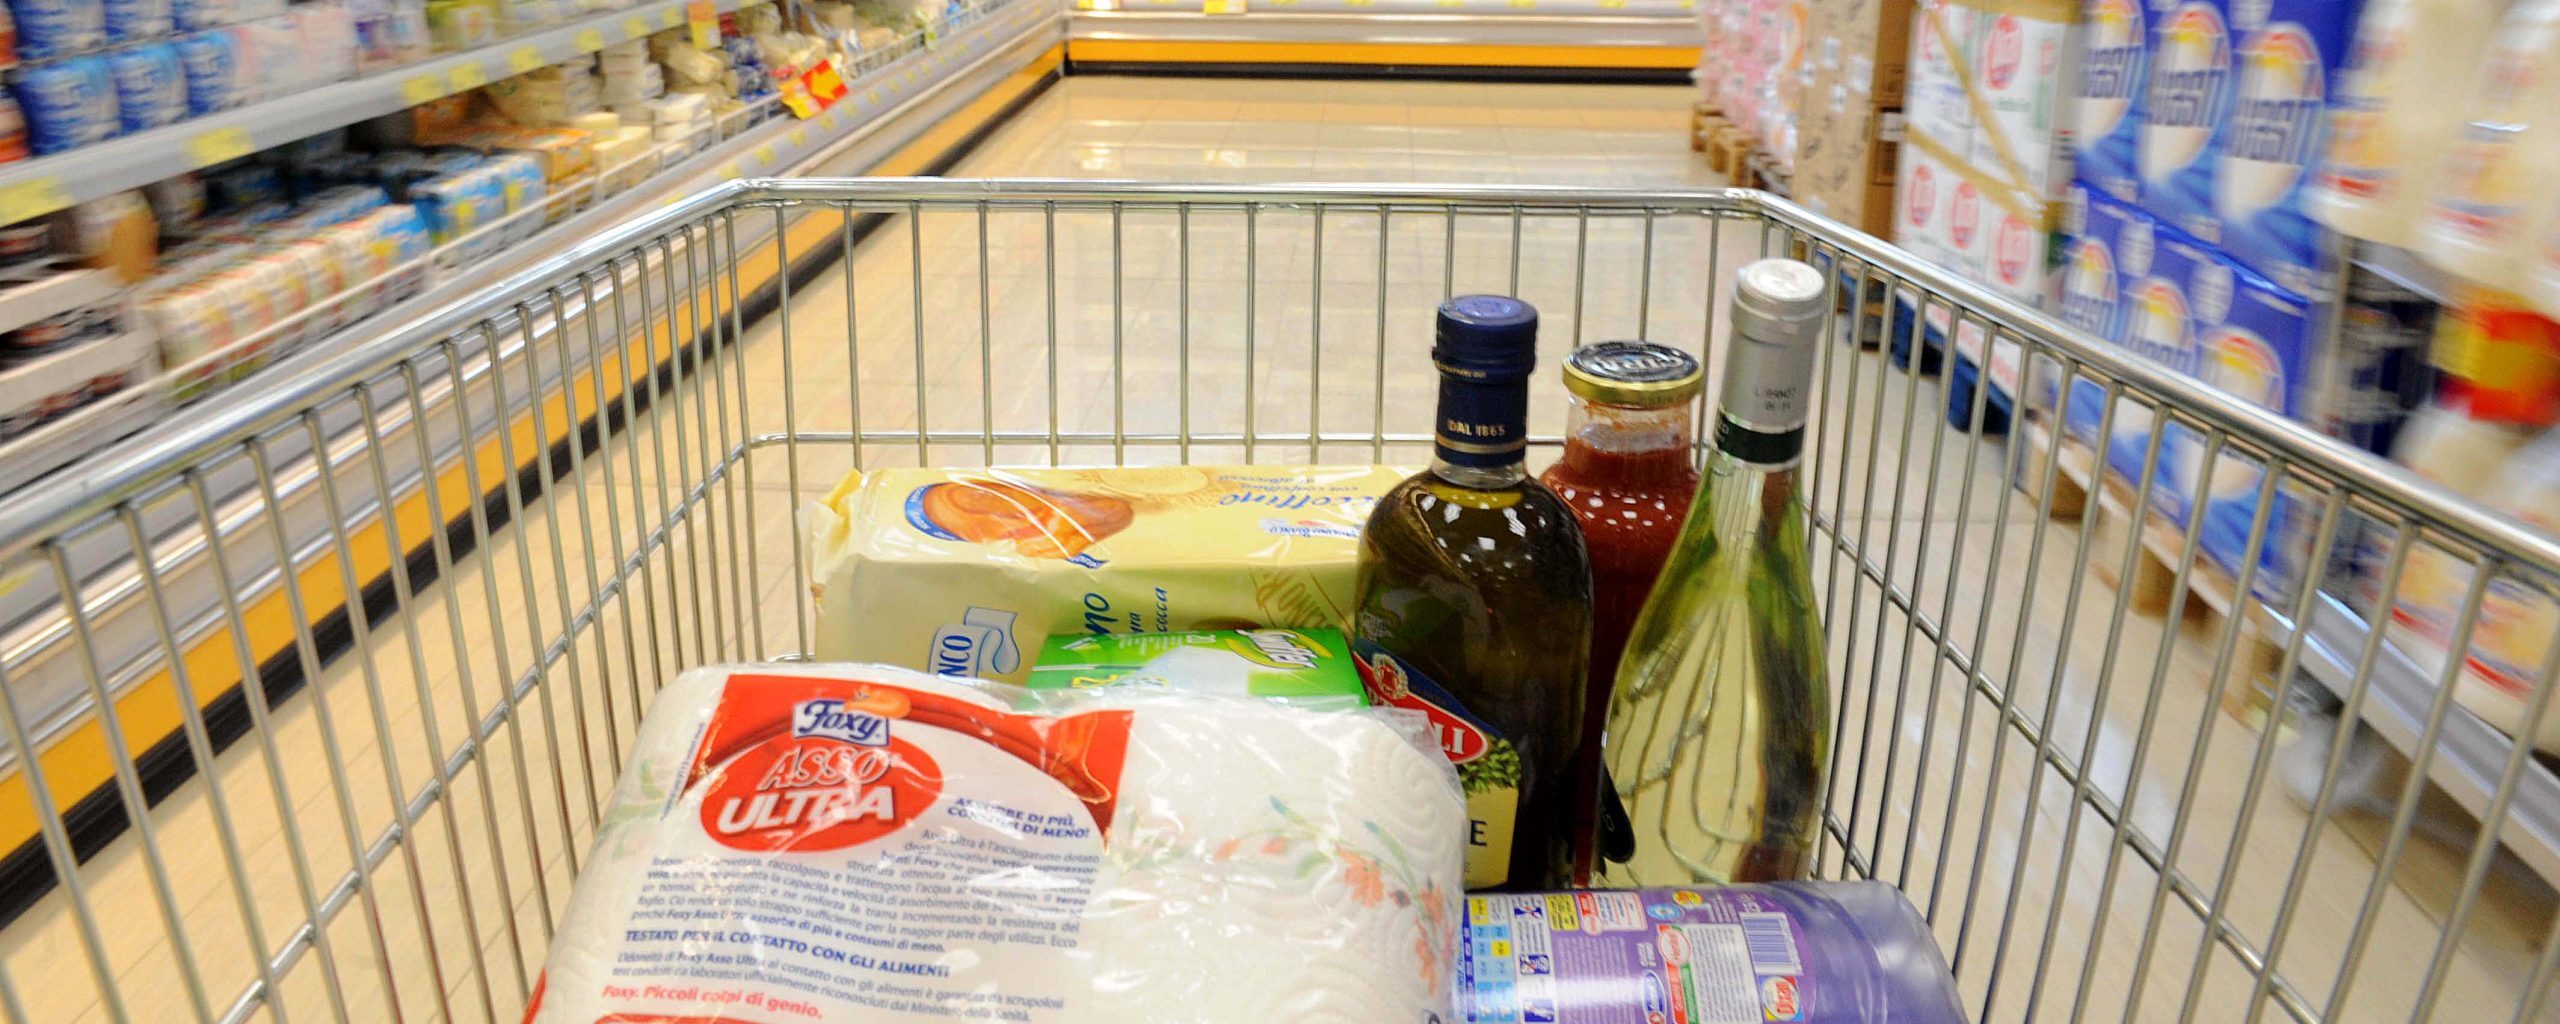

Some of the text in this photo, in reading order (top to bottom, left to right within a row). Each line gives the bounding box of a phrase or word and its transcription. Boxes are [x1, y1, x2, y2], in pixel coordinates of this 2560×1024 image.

[1447, 419, 1506, 437] DAL 1865
[938, 635, 972, 677] NCO
[799, 700, 880, 741] Foxy
[757, 746, 891, 791] ASSO
[718, 787, 894, 834] ULTRA
[1028, 813, 1043, 824] DI
[1022, 823, 1037, 836] DI
[1042, 828, 1090, 840] MENO!
[767, 859, 830, 880] raccolgono
[834, 873, 842, 881] e
[846, 874, 912, 892] trattengono
[803, 894, 845, 910] rinforza
[850, 903, 861, 913] la
[866, 907, 897, 920] trama
[988, 915, 997, 926] la
[1061, 921, 1080, 933] del
[832, 886, 840, 895] e
[842, 887, 885, 902] velocità
[886, 894, 898, 905] di
[751, 913, 796, 928] assorbe
[799, 918, 811, 930] di
[813, 923, 832, 938] più
[835, 929, 842, 938] e
[845, 931, 895, 948] consumi
[897, 938, 908, 950] di
[759, 899, 803, 915] strappo
[865, 922, 884, 933] per
[887, 923, 897, 933] la
[625, 930, 678, 942] TESTATO
[812, 945, 845, 963] CON
[850, 953, 876, 969] GLI
[878, 959, 950, 979] ALIMENTI
[705, 953, 732, 964] Asso
[781, 961, 831, 982] contatto
[833, 975, 856, 988] con
[858, 978, 874, 993] gli
[876, 981, 923, 998] alimenti
[643, 985, 699, 1000] Piccoli
[746, 990, 763, 1005] di
[768, 995, 823, 1019] genio.
